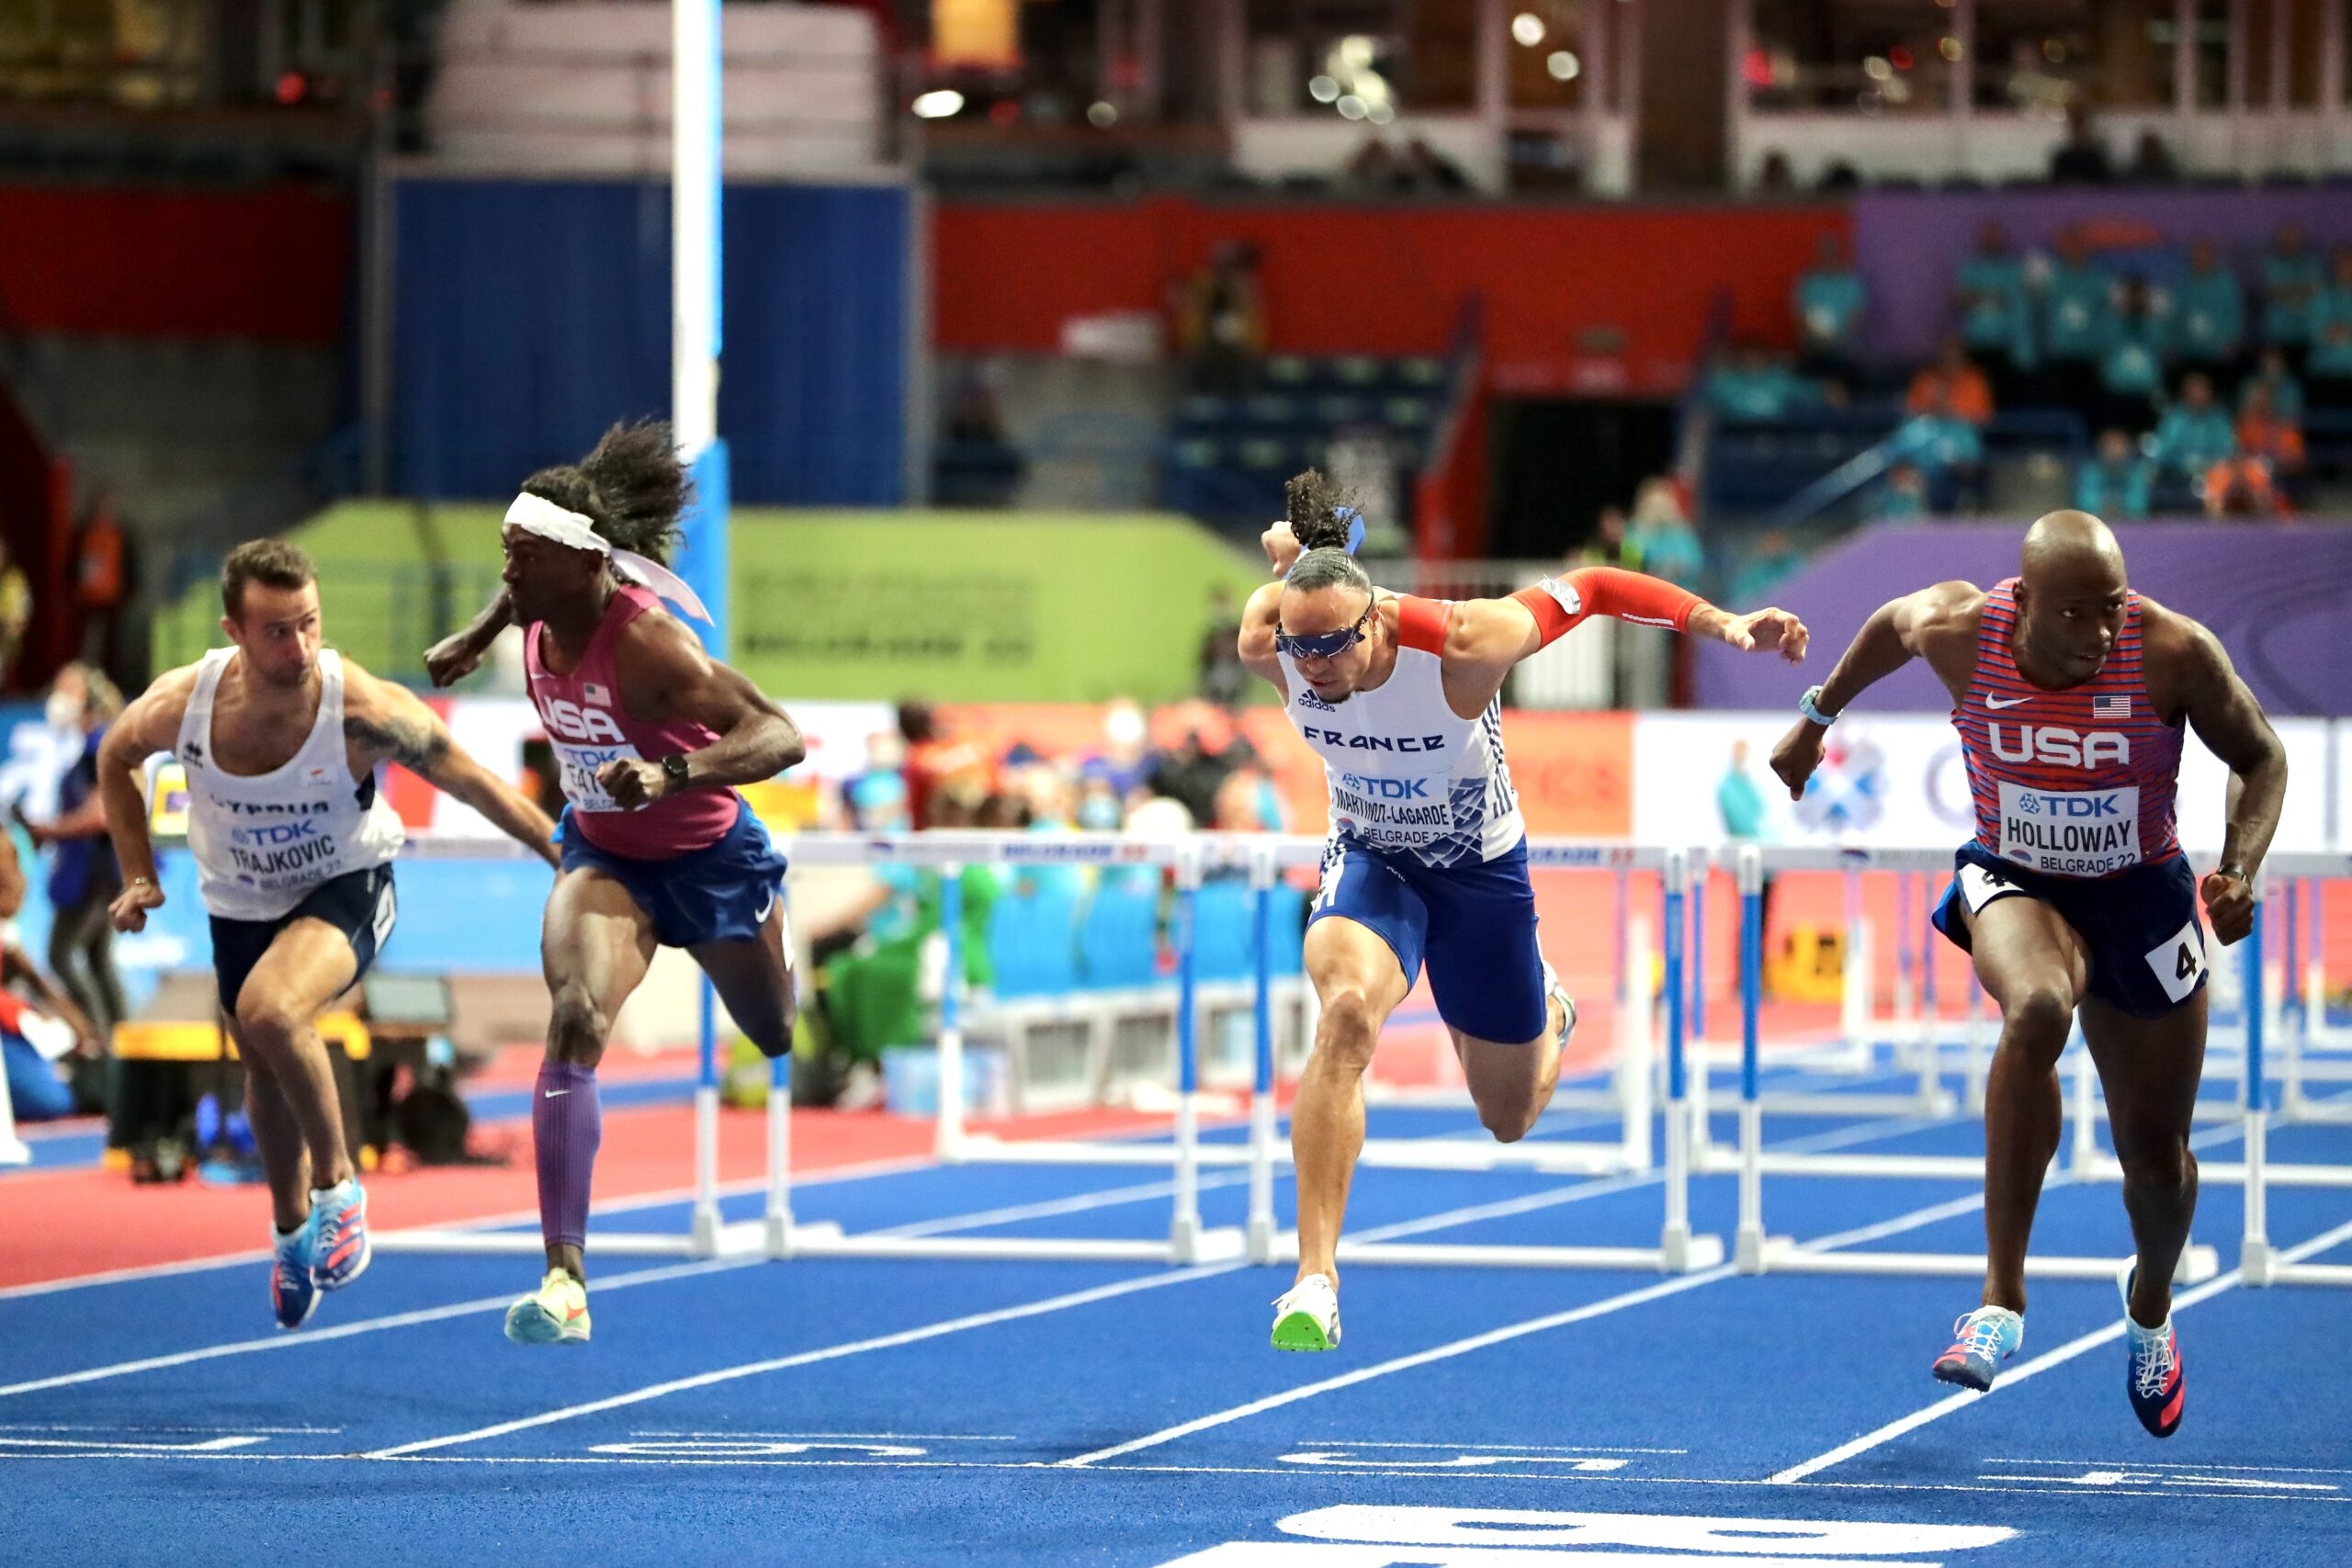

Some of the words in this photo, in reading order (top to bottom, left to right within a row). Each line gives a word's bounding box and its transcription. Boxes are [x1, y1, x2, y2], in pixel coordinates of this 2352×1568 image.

[1298, 696, 1336, 712] adidas
[544, 695, 626, 742] USA
[1304, 725, 1445, 752] FRANCE
[1988, 722, 2130, 769] USA
[564, 749, 616, 767] TDK
[1359, 777, 1429, 799] TDK
[2040, 794, 2119, 817] TDK
[248, 819, 316, 847] TDK
[1363, 827, 1430, 843] BELGRADE
[2007, 817, 2132, 853] HOLLOWAY
[230, 835, 336, 874] TRAJKOVIC
[2041, 856, 2113, 873] BELGRADE
[2118, 852, 2136, 869] 22
[2176, 942, 2198, 981] 4
